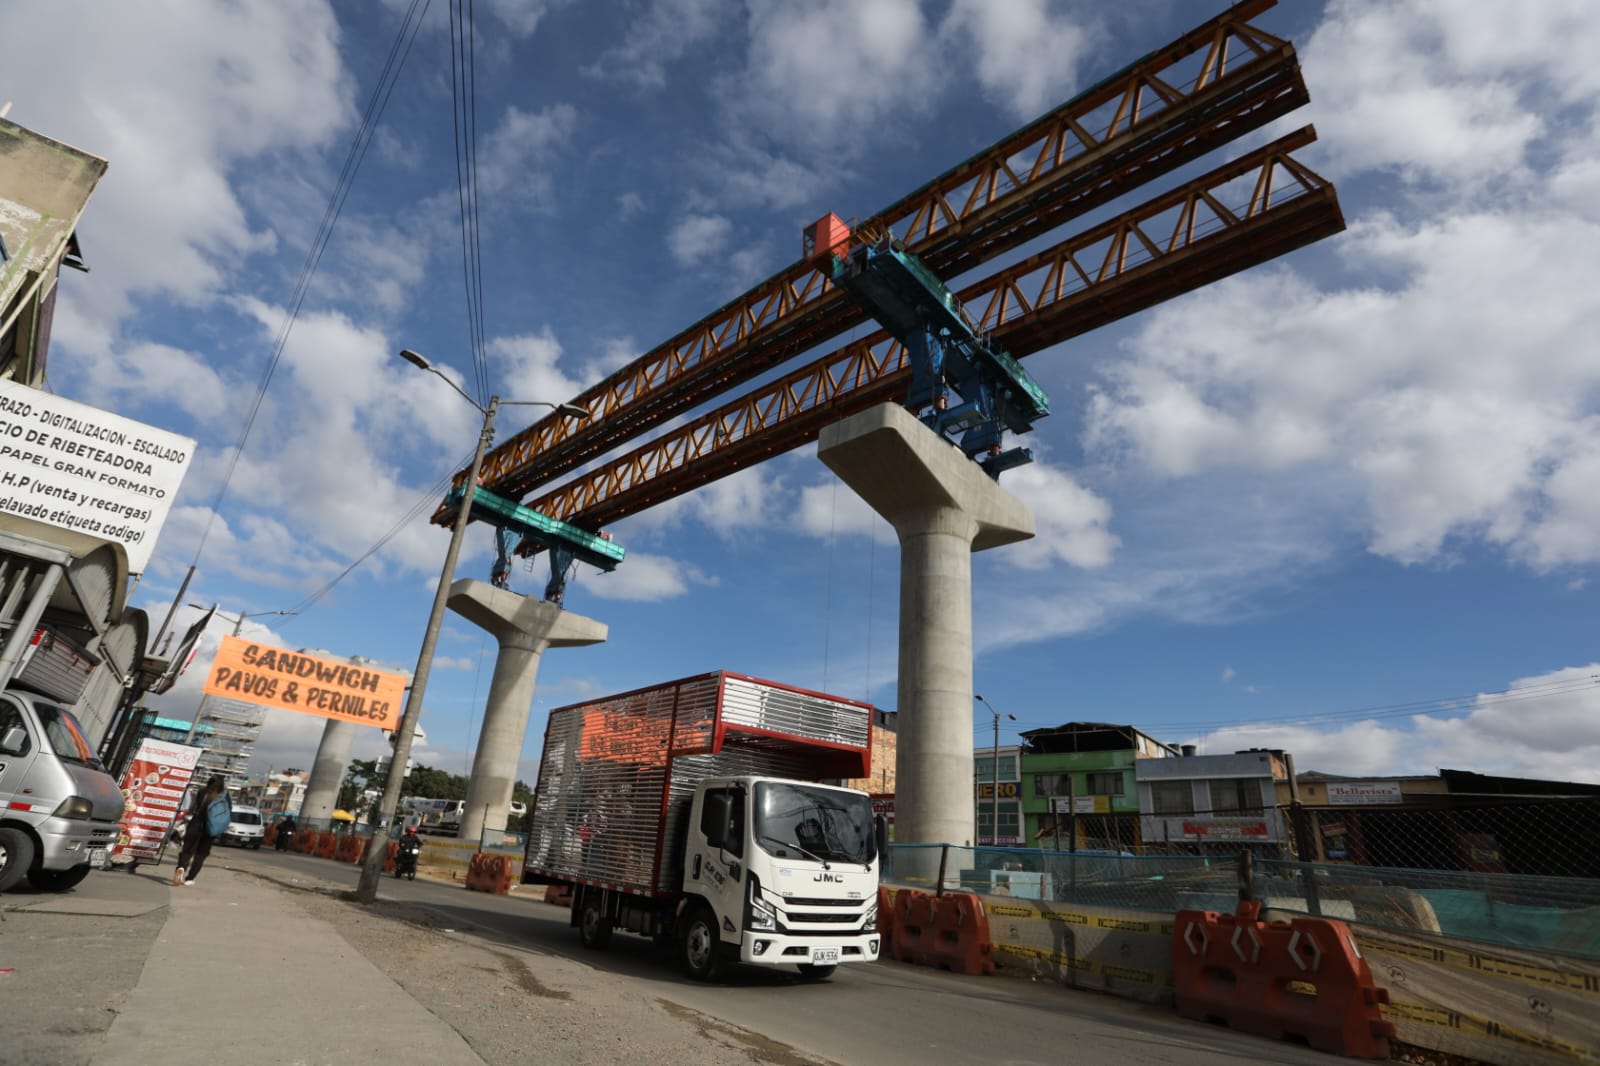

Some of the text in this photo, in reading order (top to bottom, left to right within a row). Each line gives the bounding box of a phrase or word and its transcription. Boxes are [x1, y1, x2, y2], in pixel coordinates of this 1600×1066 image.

[0, 396, 31, 418] RAZO
[40, 410, 126, 446] DIGITALIZACION
[132, 439, 186, 464] ESCALADO
[25, 429, 49, 446] DE
[50, 437, 153, 476] RIBETEADORA
[0, 445, 166, 499] PAPEL GRAN FORMATO
[30, 479, 78, 502] (venta
[77, 494, 90, 506] y
[89, 497, 152, 523] recargas)
[50, 511, 101, 532] etiqueta
[102, 522, 146, 544] codigo)
[242, 644, 381, 692] SANDWICH
[215, 667, 390, 722] PAVOS & PERNILES
[813, 872, 844, 885] JMC
